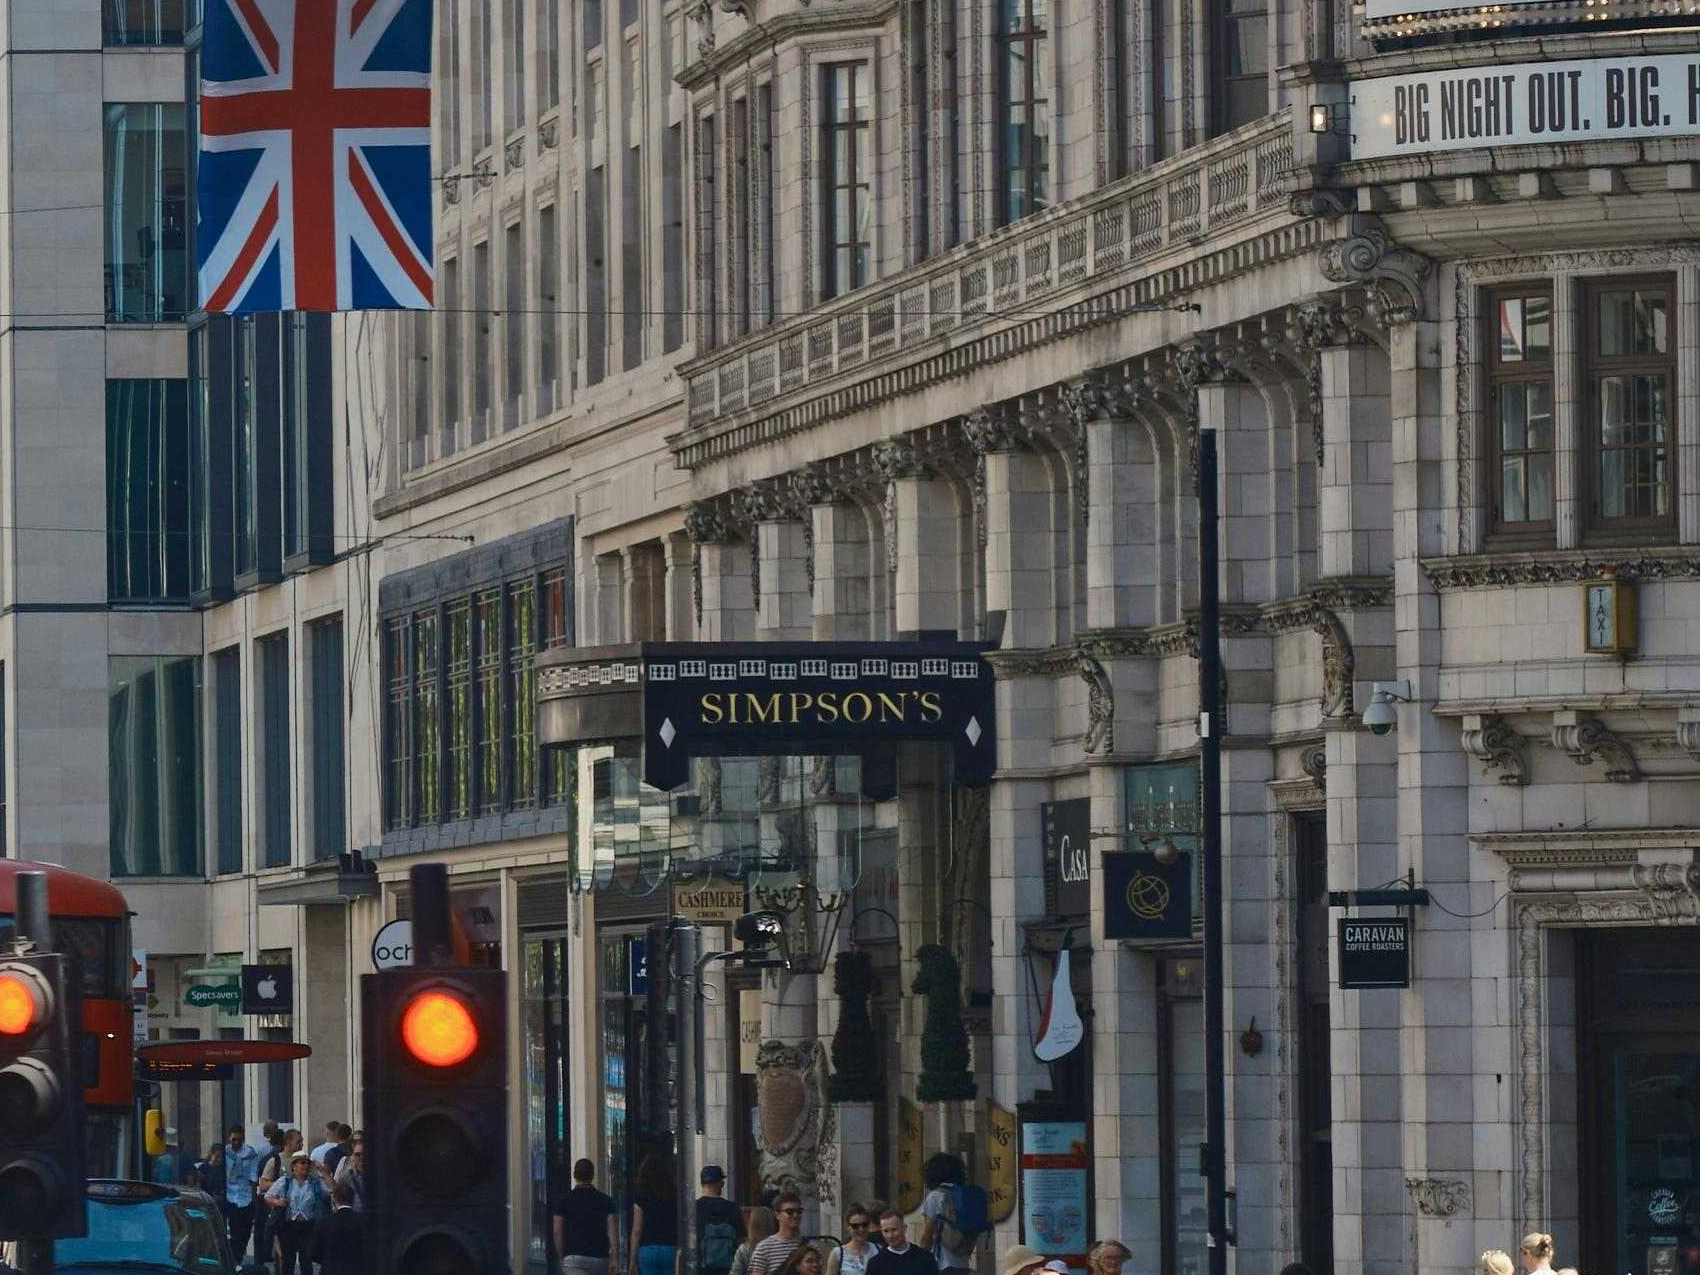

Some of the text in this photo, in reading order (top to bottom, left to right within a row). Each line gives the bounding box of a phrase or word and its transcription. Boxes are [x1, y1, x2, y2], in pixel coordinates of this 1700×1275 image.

[1394, 81, 1429, 146] BIG
[1441, 74, 1517, 142] NIGHT
[1528, 69, 1591, 135] OUT.
[1605, 64, 1671, 128] BIG.
[1596, 588, 1607, 646] TAXI
[701, 690, 944, 726] SIMPSON'S
[1346, 927, 1404, 942] CARAVAN
[191, 989, 239, 1001] Specsavers
